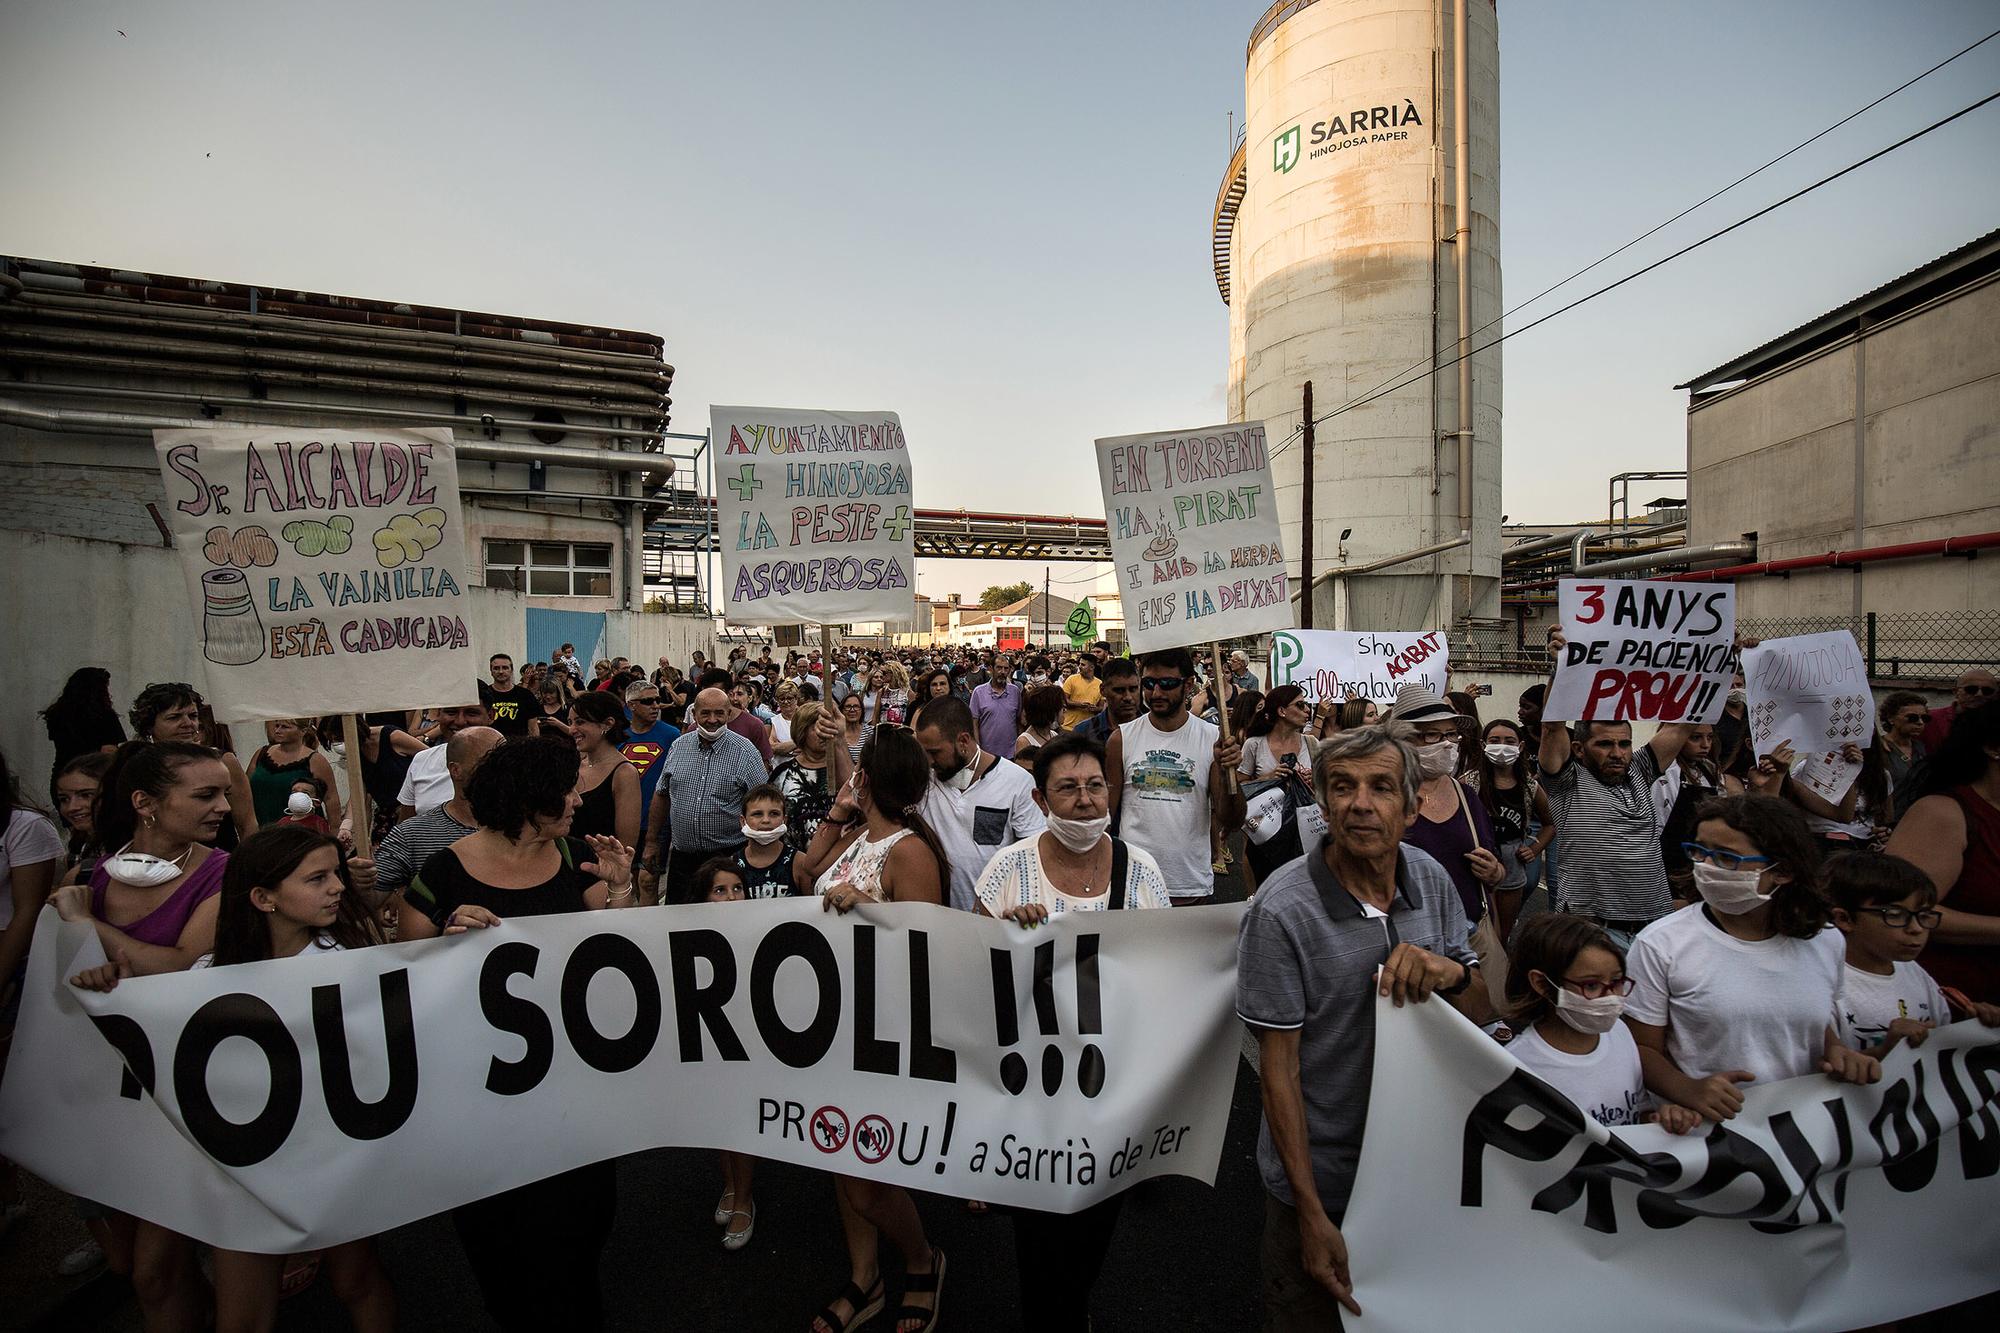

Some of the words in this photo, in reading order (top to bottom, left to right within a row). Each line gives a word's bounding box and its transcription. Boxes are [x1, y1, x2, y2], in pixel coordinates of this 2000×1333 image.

[1309, 99, 1422, 145] SARRIÀ
[1310, 137, 1368, 160] HINOJOSA
[1371, 131, 1408, 143] PAPER
[724, 420, 906, 455] AYUNTAMIENTO
[1111, 445, 1152, 495] EN
[1154, 426, 1266, 489] TORRENT
[167, 444, 231, 516] Sr.
[785, 460, 909, 499] HINOJOSA
[736, 511, 779, 551] LA
[790, 503, 881, 546] PESTE
[1115, 506, 1153, 540] HA
[1173, 484, 1261, 531] PIRAT
[732, 556, 907, 602] ASQUEROSA
[1126, 563, 1142, 590] I
[1153, 556, 1198, 585] AMB
[1203, 550, 1226, 574] LA
[1230, 541, 1284, 569] MERDA
[268, 576, 314, 611] LA
[1138, 592, 1176, 631] ENS
[1185, 589, 1217, 620] HA
[1218, 572, 1288, 612] DEIXAT
[1575, 585, 1606, 624] 3
[1613, 585, 1727, 637] ANYS
[340, 615, 468, 653] CADUCADA
[1386, 632, 1440, 680] ACABAT
[1566, 640, 1610, 667] DE
[479, 921, 957, 1096] SOROLL
[970, 1139, 989, 1173] a
[995, 1133, 1096, 1186] Sarrià
[1109, 1137, 1143, 1179] de
[1149, 1122, 1191, 1161] Ter
